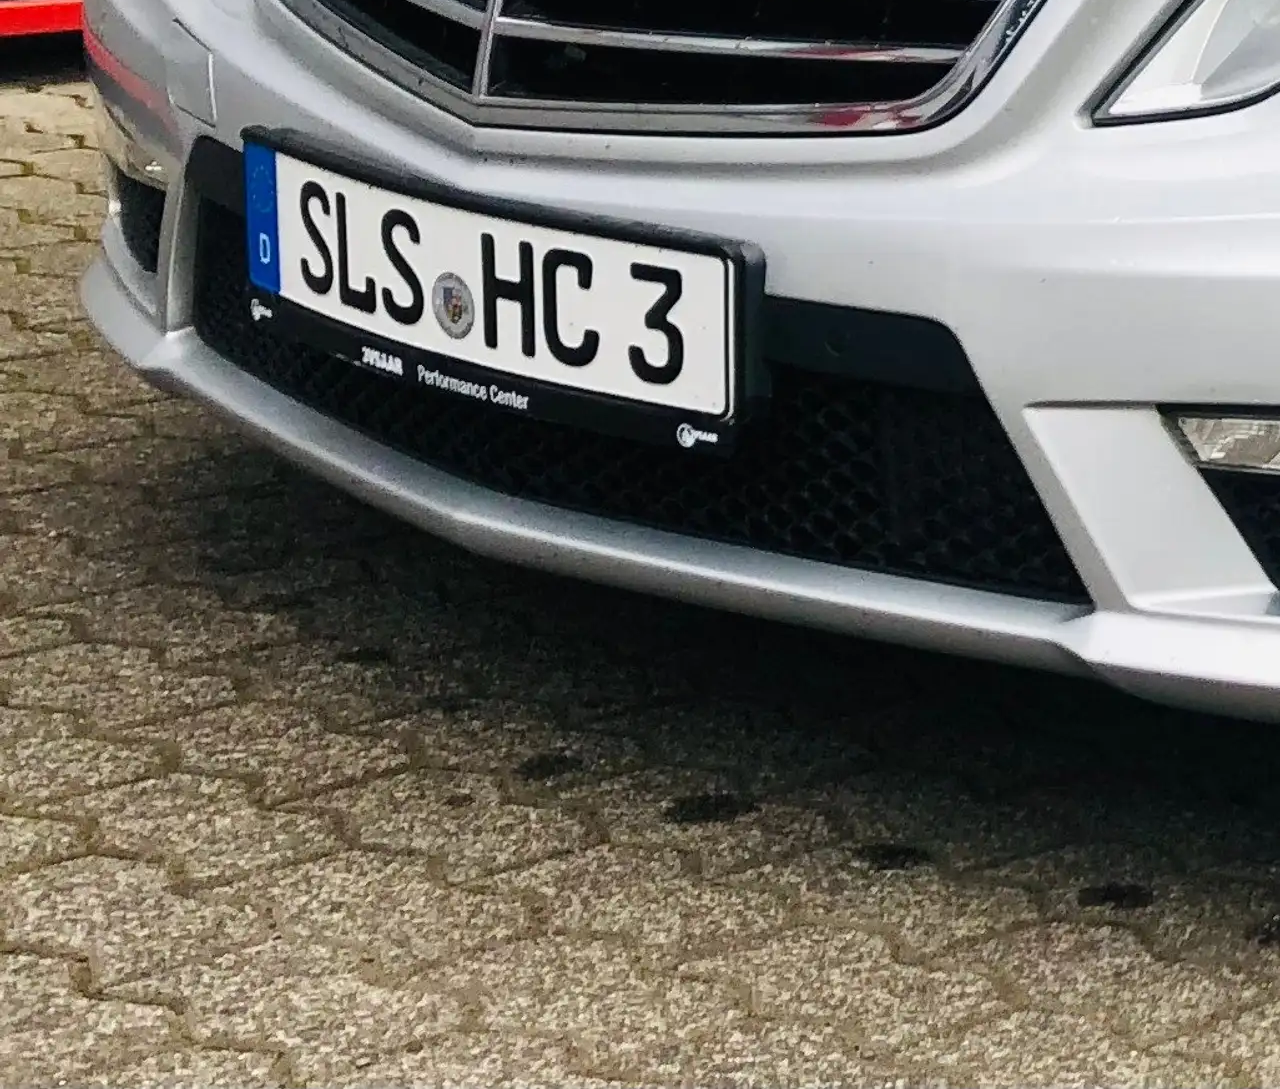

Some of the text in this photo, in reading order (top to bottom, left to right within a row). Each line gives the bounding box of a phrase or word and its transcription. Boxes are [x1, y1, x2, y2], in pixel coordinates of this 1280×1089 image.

[259, 232, 270, 264] D
[300, 180, 684, 385] SLS HC 3
[417, 364, 529, 409] Performance Center
